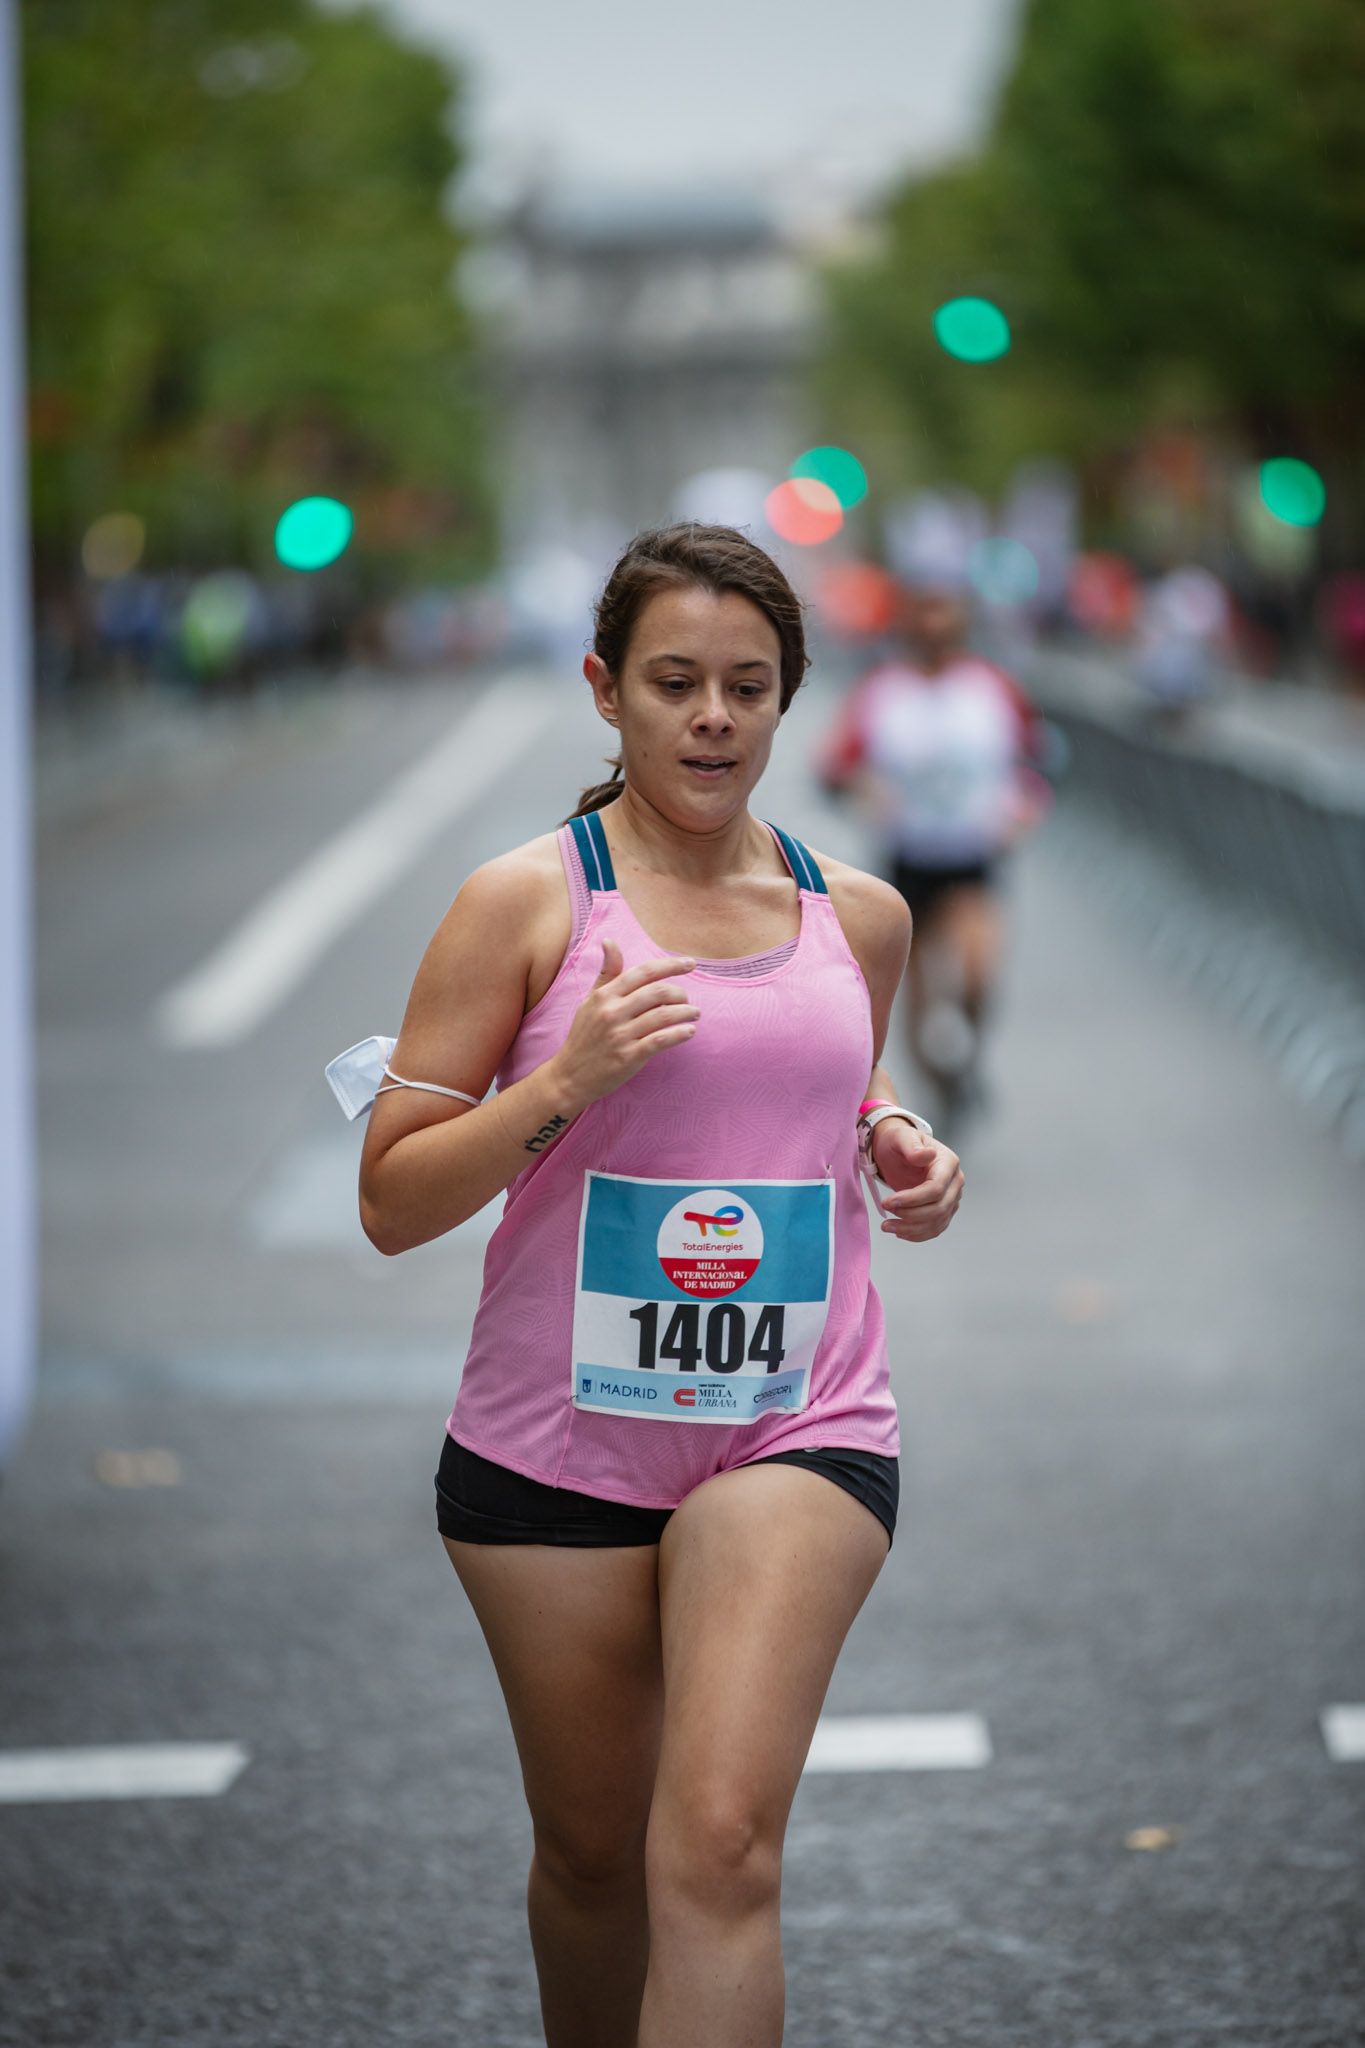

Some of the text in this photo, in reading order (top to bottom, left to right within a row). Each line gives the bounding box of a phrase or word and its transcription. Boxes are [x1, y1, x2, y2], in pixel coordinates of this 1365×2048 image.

[682, 1242, 744, 1253] TotalEnergies
[696, 1262, 726, 1270] MILLA
[684, 1281, 736, 1290] DE MADRID
[629, 1302, 786, 1374] 1404
[600, 1382, 658, 1400] MADRID
[699, 1389, 733, 1398] MILLA
[698, 1399, 737, 1408] URBANA
